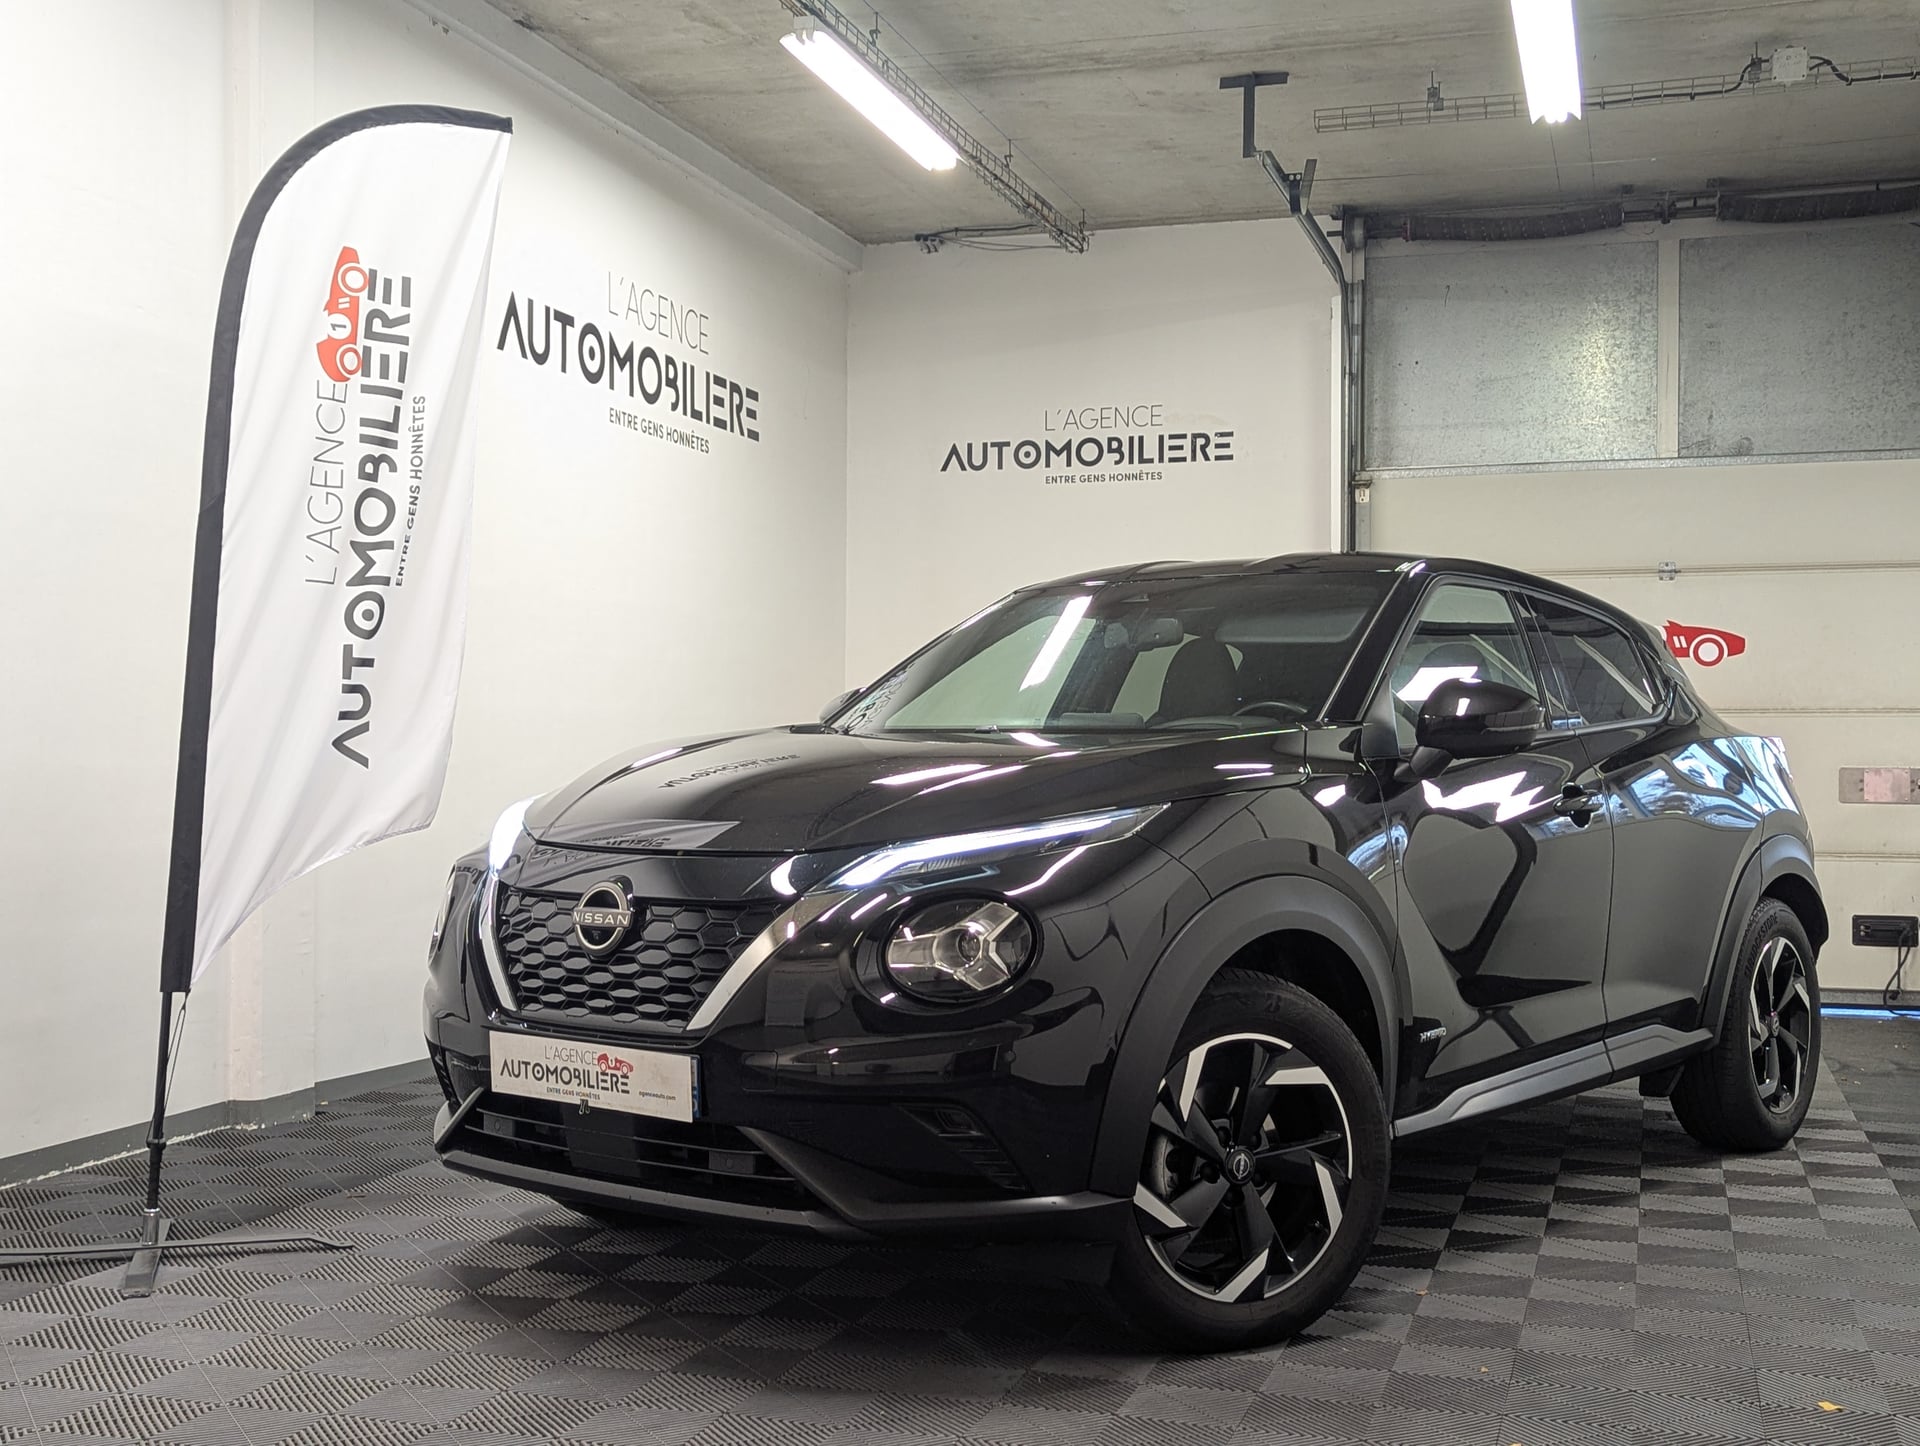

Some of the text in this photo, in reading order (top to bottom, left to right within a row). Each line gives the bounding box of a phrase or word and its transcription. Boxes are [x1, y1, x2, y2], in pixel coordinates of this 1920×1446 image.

[608, 271, 709, 355] L'AGENCE
[497, 291, 759, 442] AUTOMOBILIERE
[609, 407, 710, 454] ENTRE GENS HONNÊTES
[1044, 404, 1163, 432] L'AGENCE
[940, 430, 1234, 473] AUTOMOBILIERE
[305, 379, 348, 585] L'AGENCE
[395, 395, 427, 586] ENTRE GENS HONNÊTES
[1045, 470, 1163, 485] ENTRE GENS HONNÊTES
[331, 268, 412, 768] AUTOMOBILIERE
[573, 911, 629, 925] NISSAN
[500, 1058, 630, 1095] AUTOMOBILIERE
[544, 1044, 597, 1066] L'AGENCE
[546, 1087, 561, 1095] ENTRE
